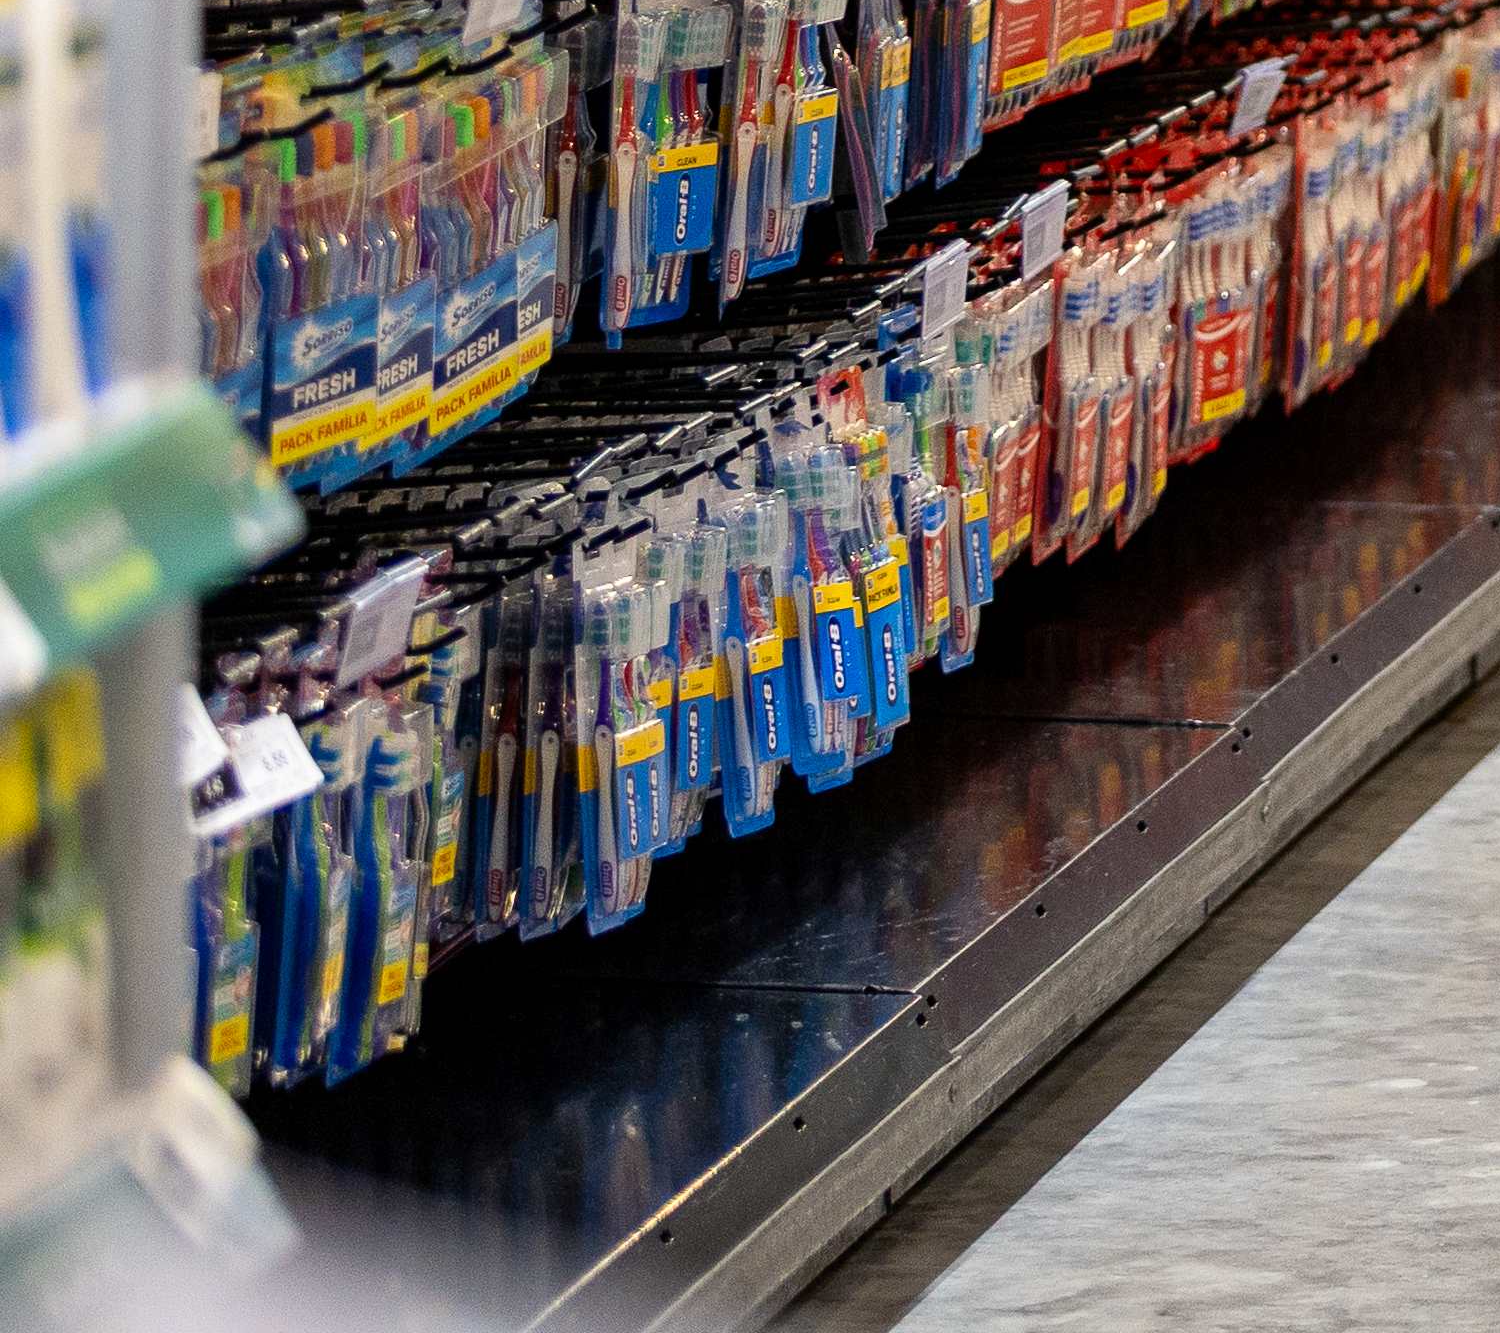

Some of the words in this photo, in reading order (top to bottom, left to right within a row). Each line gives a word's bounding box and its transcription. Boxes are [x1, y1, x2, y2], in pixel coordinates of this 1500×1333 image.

[676, 178, 690, 240] Oral-B
[446, 328, 500, 378] FRESH
[293, 369, 357, 409] FRESH
[435, 396, 466, 423] PACK
[279, 428, 315, 454] PACK
[829, 623, 845, 691] Oral-B
[884, 630, 896, 703] Oral-B
[688, 713, 699, 779] Oral-B
[764, 684, 778, 751] Oral-B
